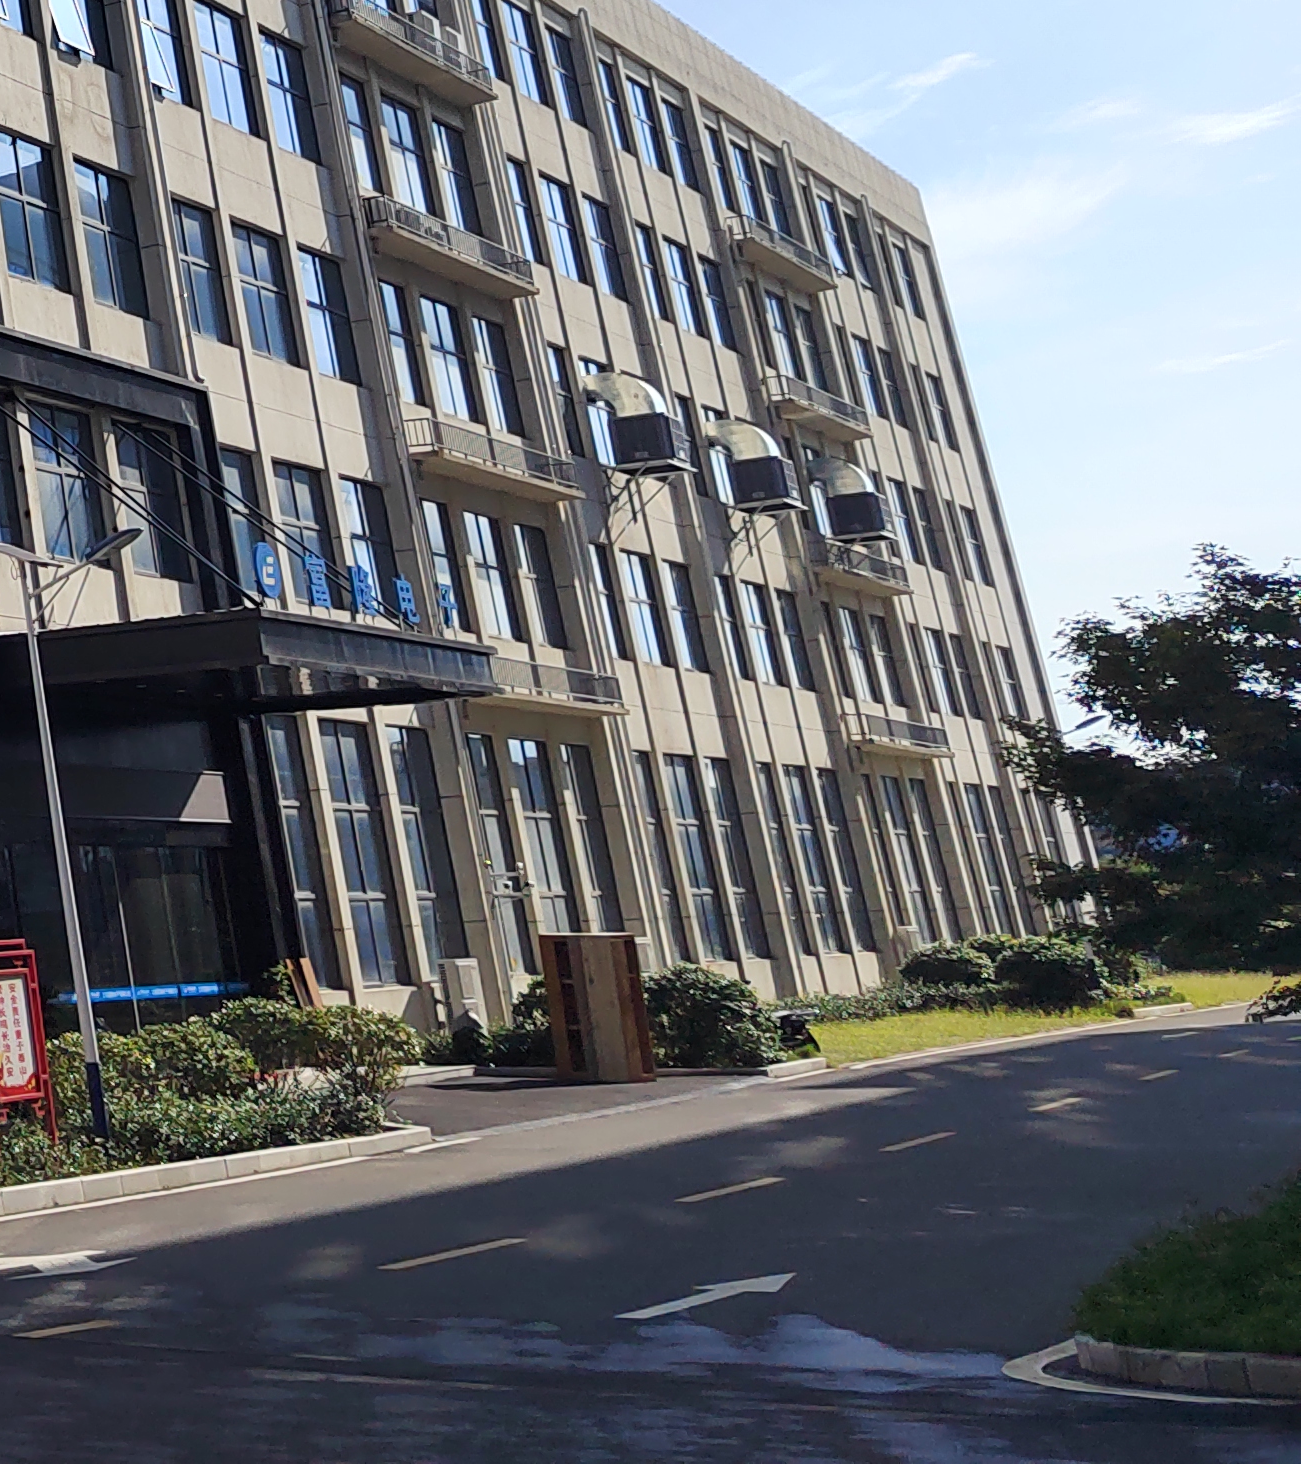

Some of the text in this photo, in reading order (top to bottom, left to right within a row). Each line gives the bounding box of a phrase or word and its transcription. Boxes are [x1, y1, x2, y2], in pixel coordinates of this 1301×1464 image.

[303, 551, 459, 626] 富隆电子
[7, 983, 28, 1076] 安全责任重于泰山
